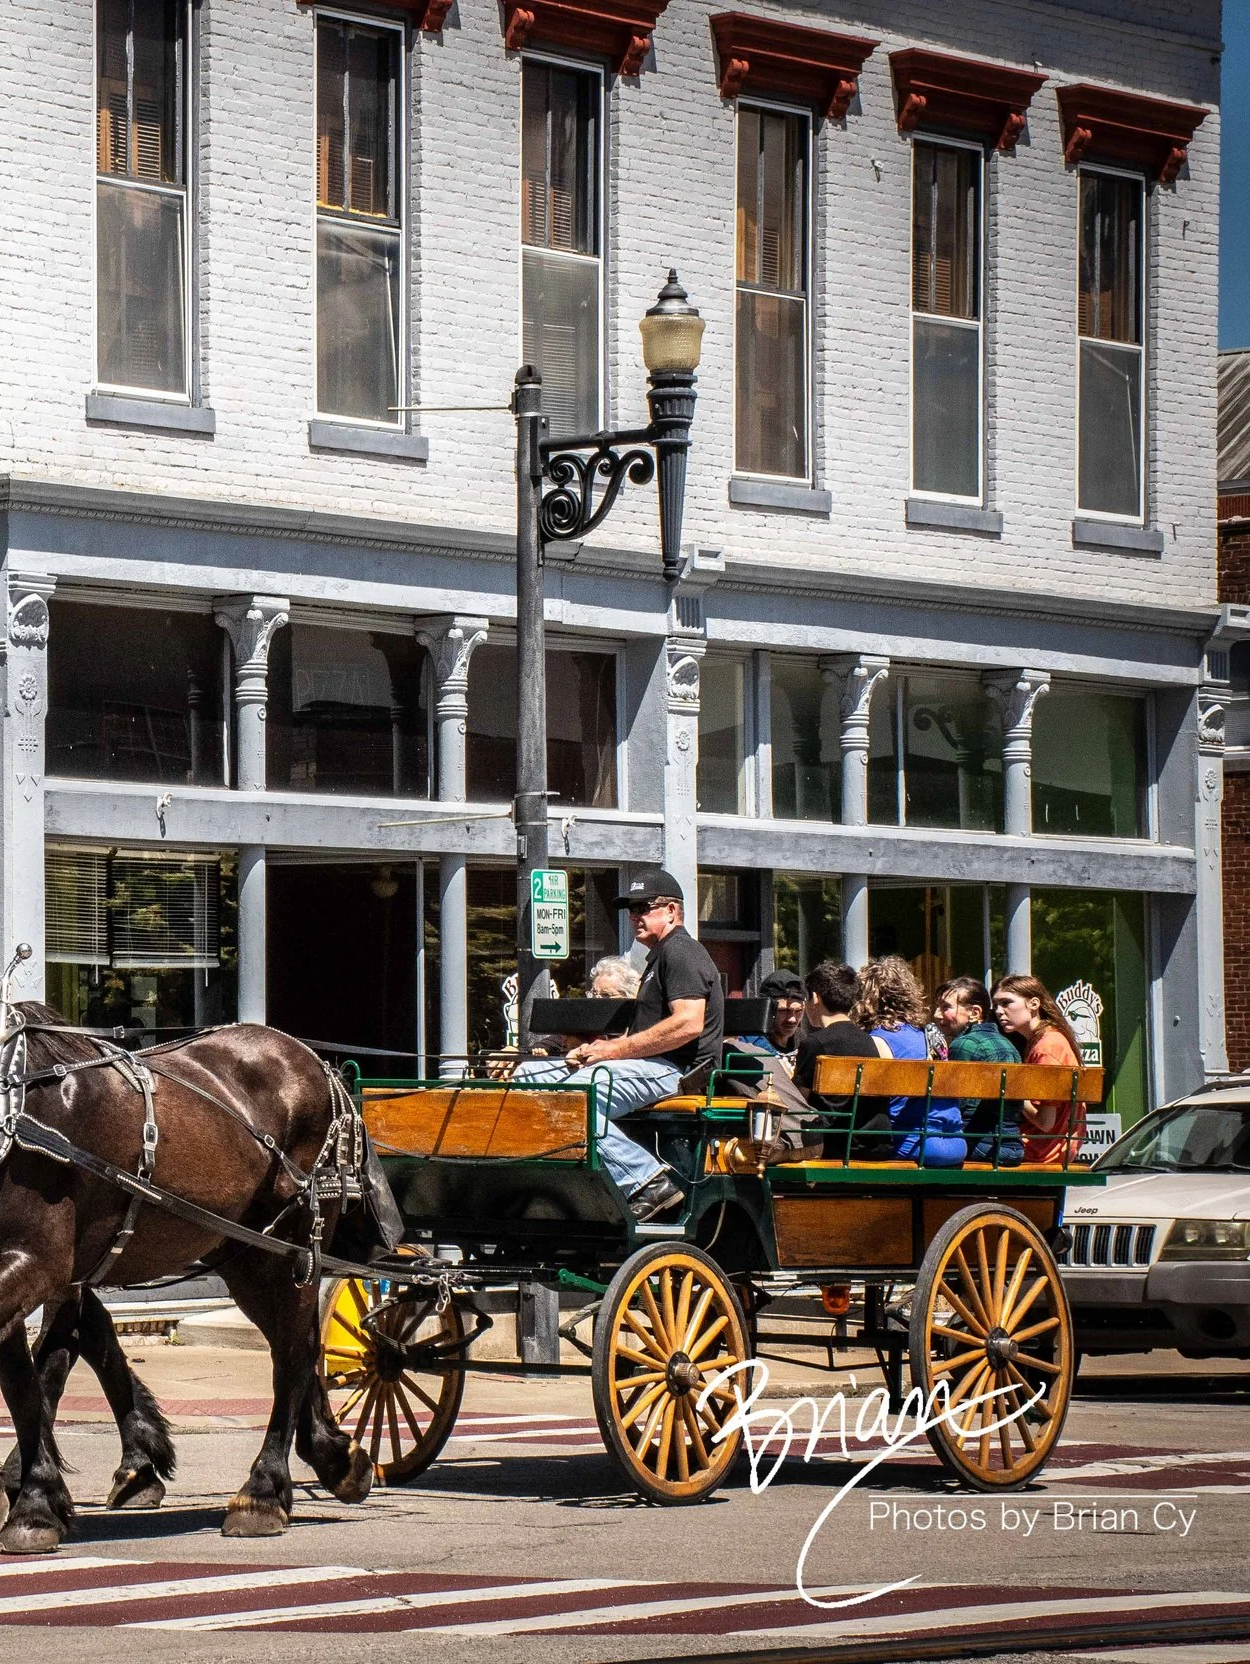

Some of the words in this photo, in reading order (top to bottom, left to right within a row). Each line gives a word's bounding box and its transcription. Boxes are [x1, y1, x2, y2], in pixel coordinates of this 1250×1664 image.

[533, 877, 542, 899] 2
[544, 889, 566, 900] PARKING
[536, 908, 566, 920] MON-FRI
[536, 923, 564, 936] 8am-5pm
[1057, 982, 1101, 1015] Buddy's
[1074, 1206, 1098, 1215] Jeep
